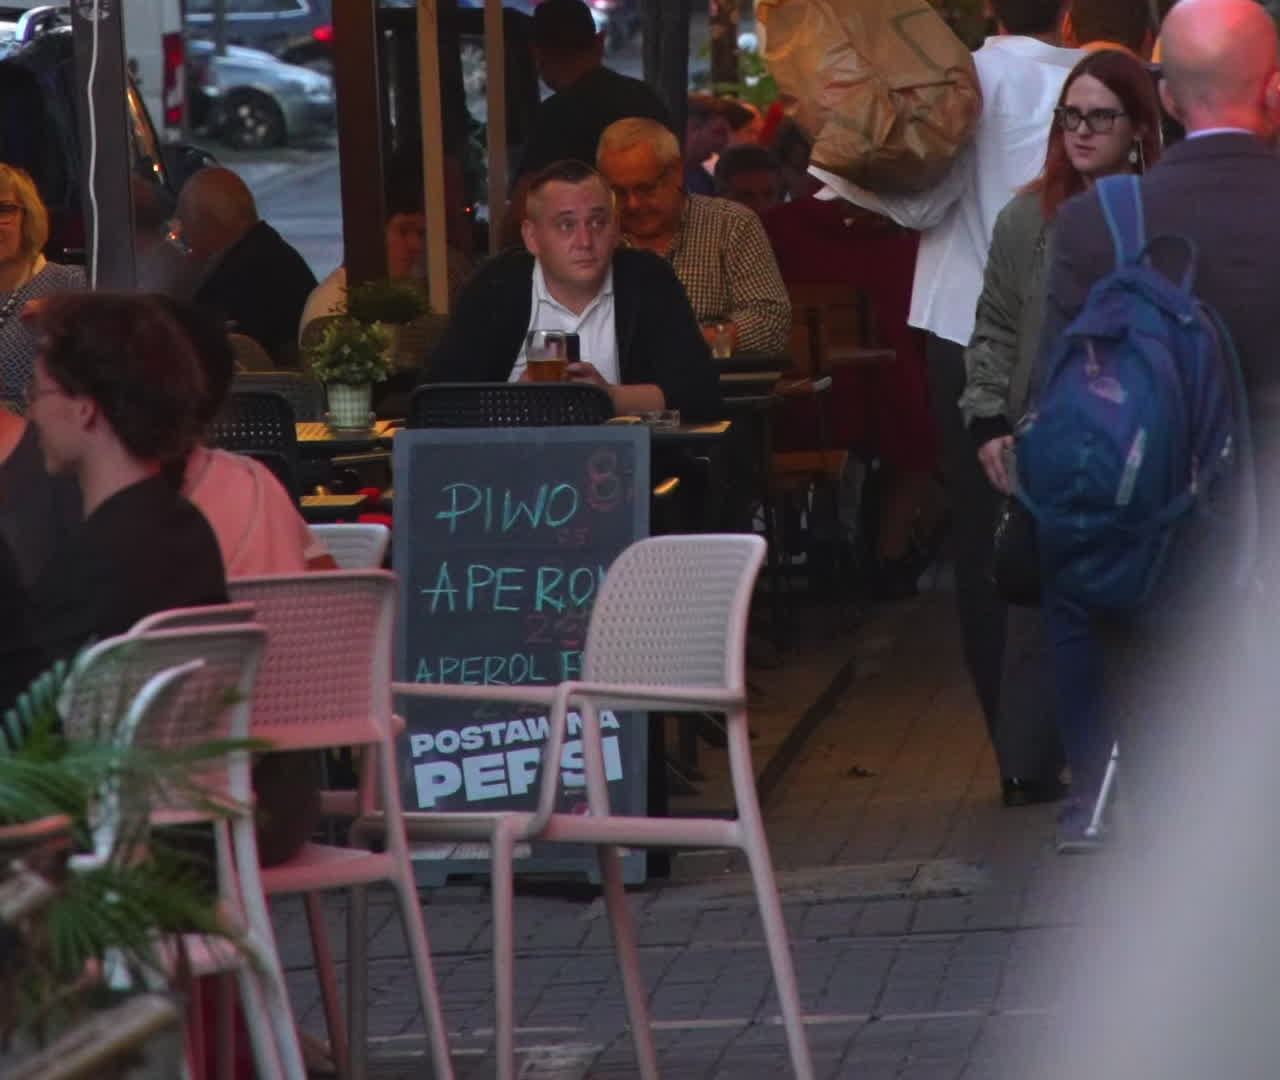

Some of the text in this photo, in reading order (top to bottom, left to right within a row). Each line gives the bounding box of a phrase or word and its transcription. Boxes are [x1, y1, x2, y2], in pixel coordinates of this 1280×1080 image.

[434, 482, 578, 533] PIWO
[420, 561, 609, 614] APERO
[415, 653, 545, 686] APEROL
[410, 716, 552, 758] POSTAW
[414, 735, 624, 809] PEPSI
